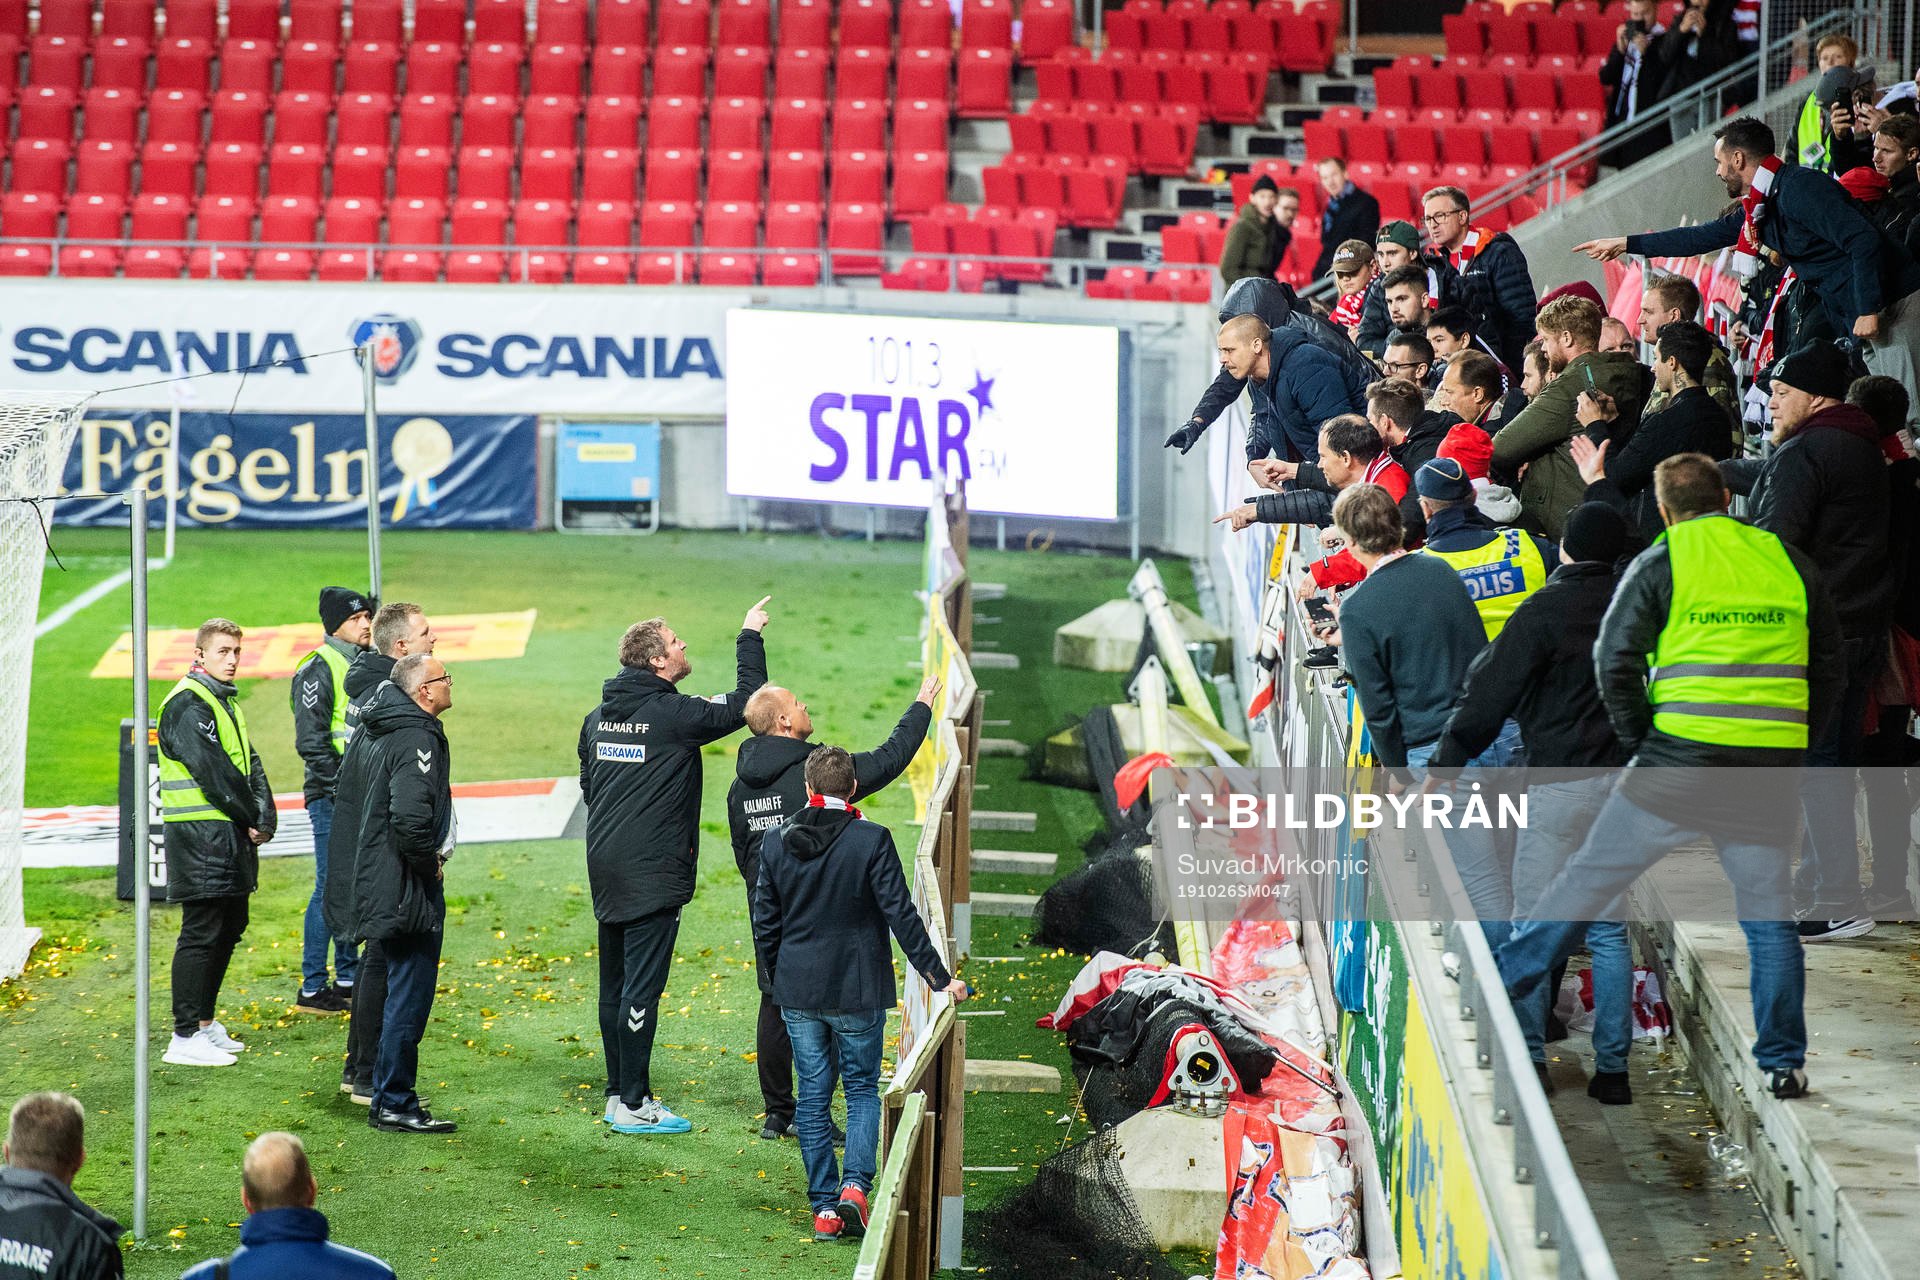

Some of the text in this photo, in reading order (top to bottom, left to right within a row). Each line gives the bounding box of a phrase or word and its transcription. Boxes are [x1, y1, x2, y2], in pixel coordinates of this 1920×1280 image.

[14, 327, 309, 374] SCANIA
[436, 333, 723, 379] SCANIA
[809, 392, 972, 482] STAR
[80, 418, 372, 523] Fågeln
[1463, 571, 1515, 600] OLIS
[597, 721, 650, 734] KALMAR FF
[598, 745, 644, 760] YASKAWA
[743, 795, 782, 815] KALMAR FF
[747, 814, 784, 832] SÄKERHET
[0, 1237, 54, 1275] RDARE
